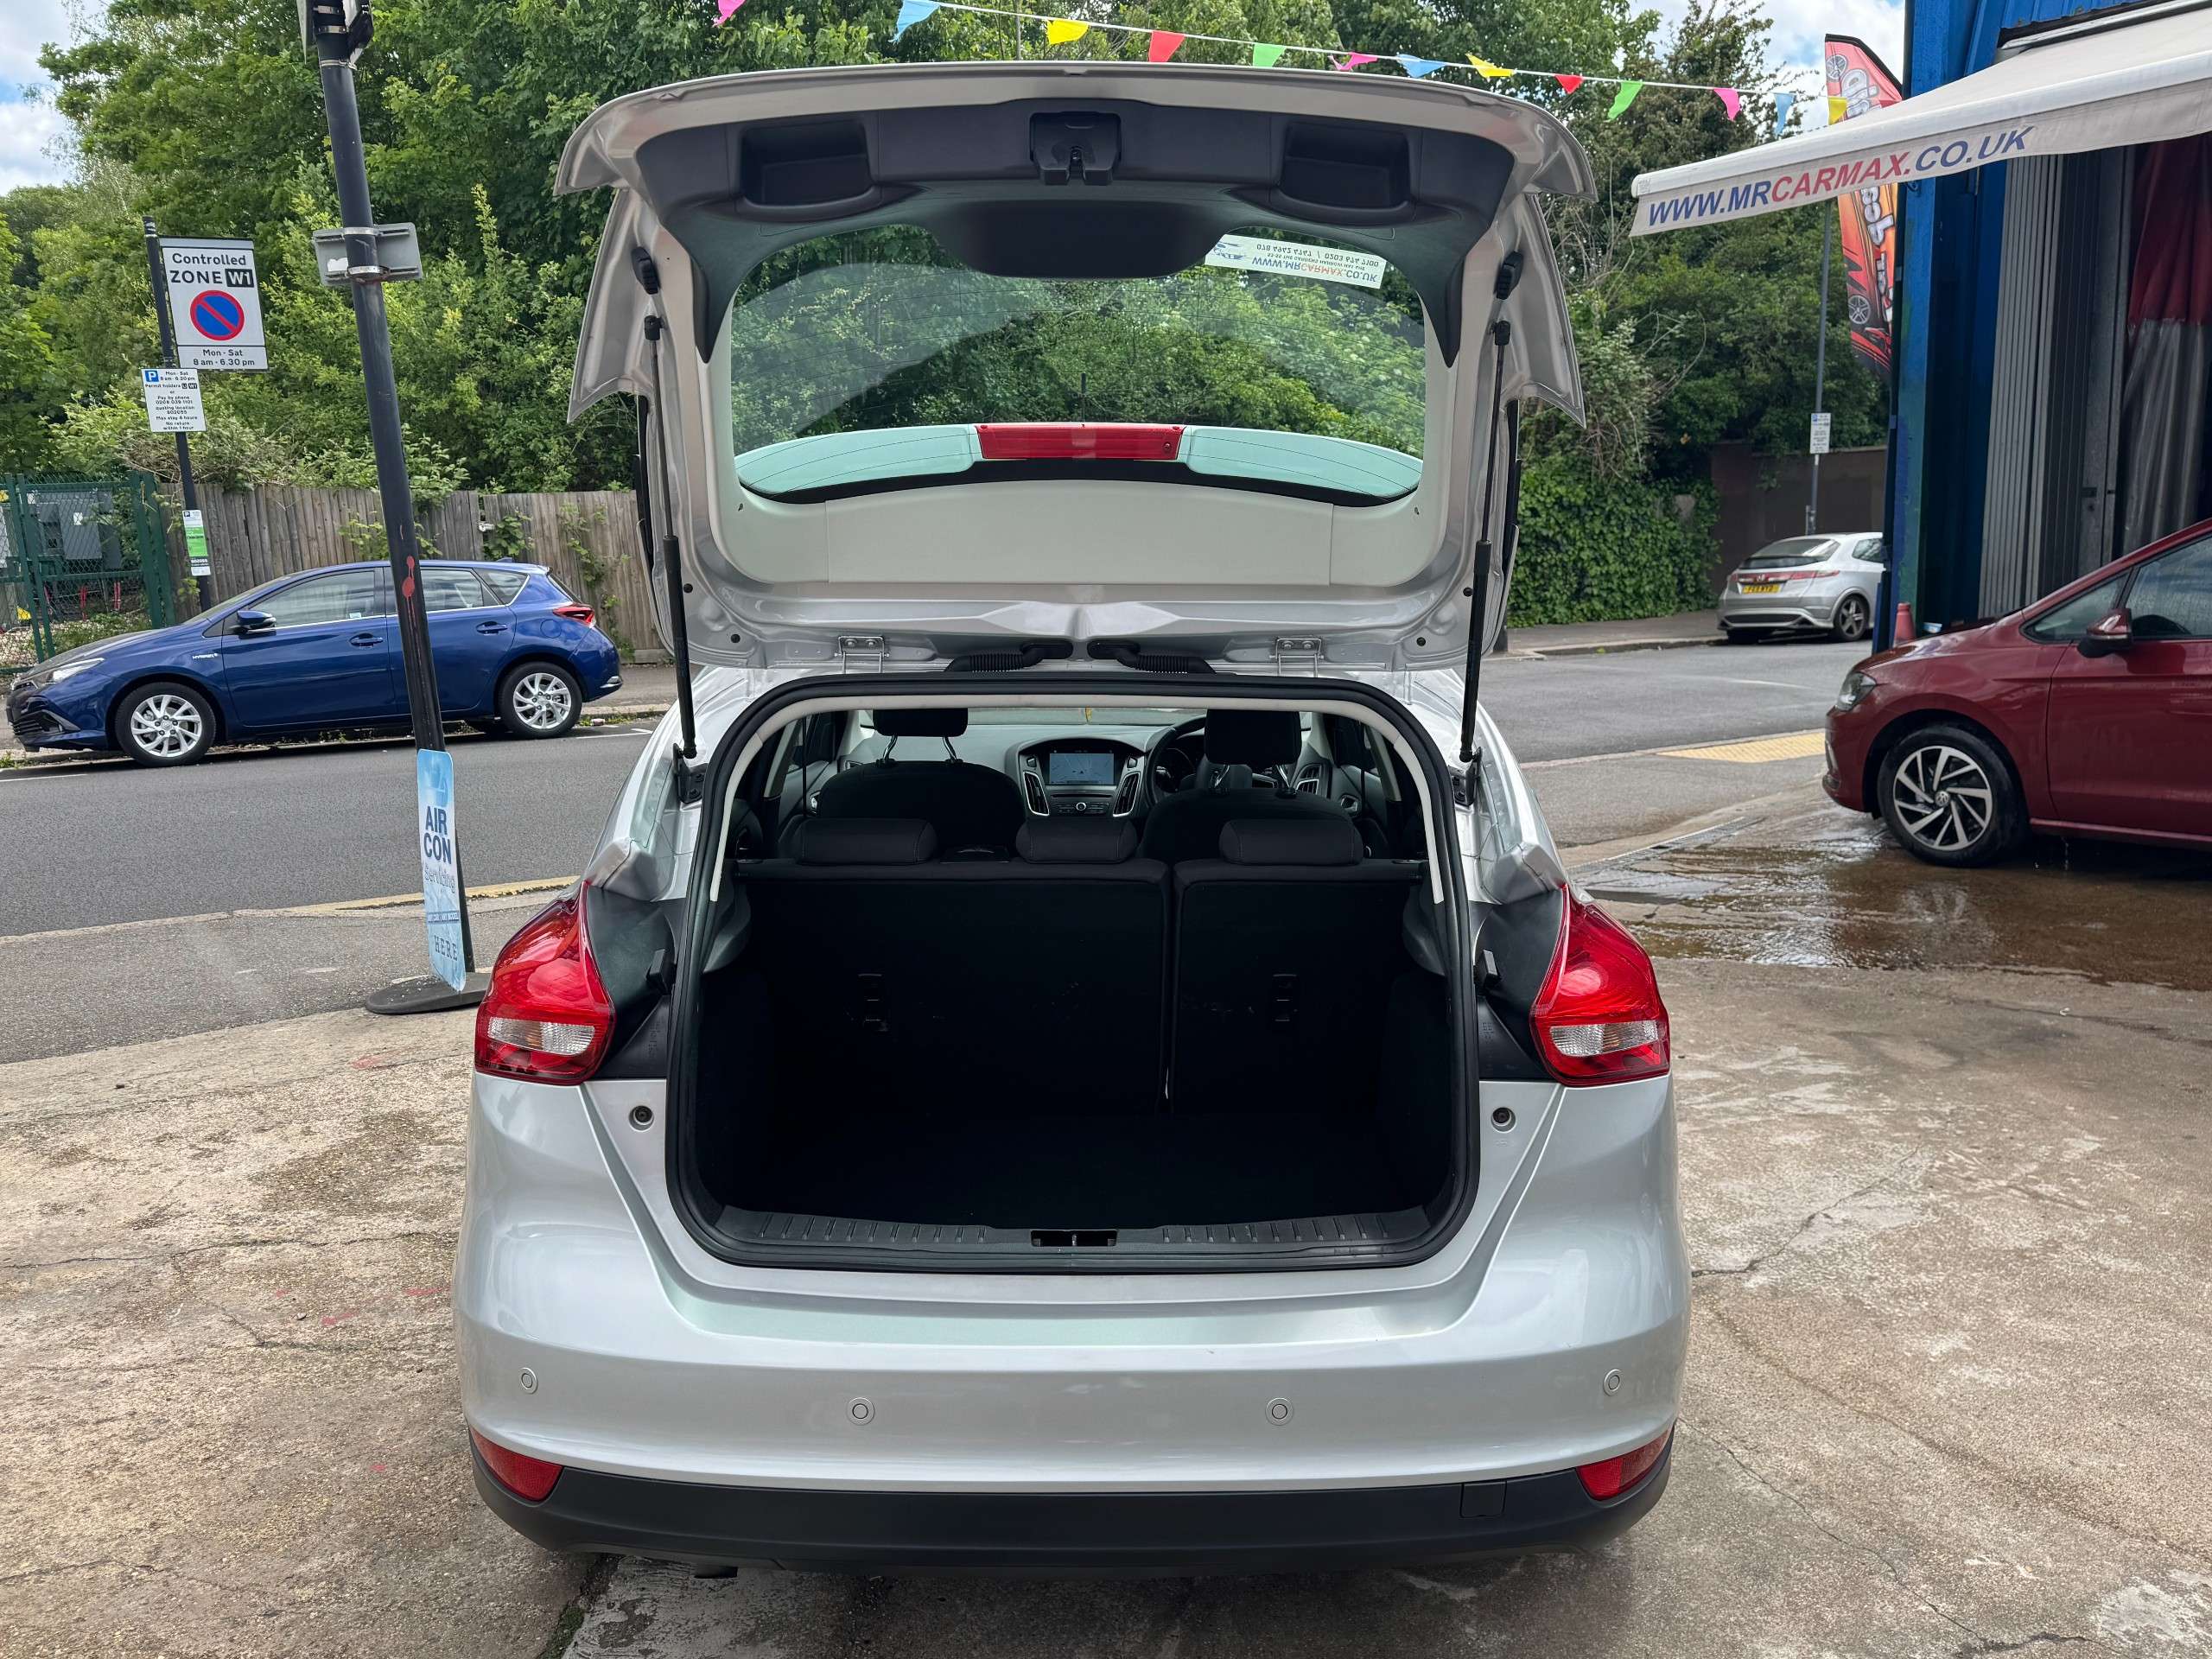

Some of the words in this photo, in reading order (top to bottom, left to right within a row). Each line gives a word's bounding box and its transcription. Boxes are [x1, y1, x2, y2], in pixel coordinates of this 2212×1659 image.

[1649, 125, 2034, 226] WWW.MRCARMAX.CO.UK
[172, 252, 247, 266] Controlled
[169, 270, 223, 284] ZONE
[226, 270, 252, 286] W1
[425, 805, 448, 836] AIR
[423, 835, 452, 865] CON
[434, 935, 458, 961] HERE
